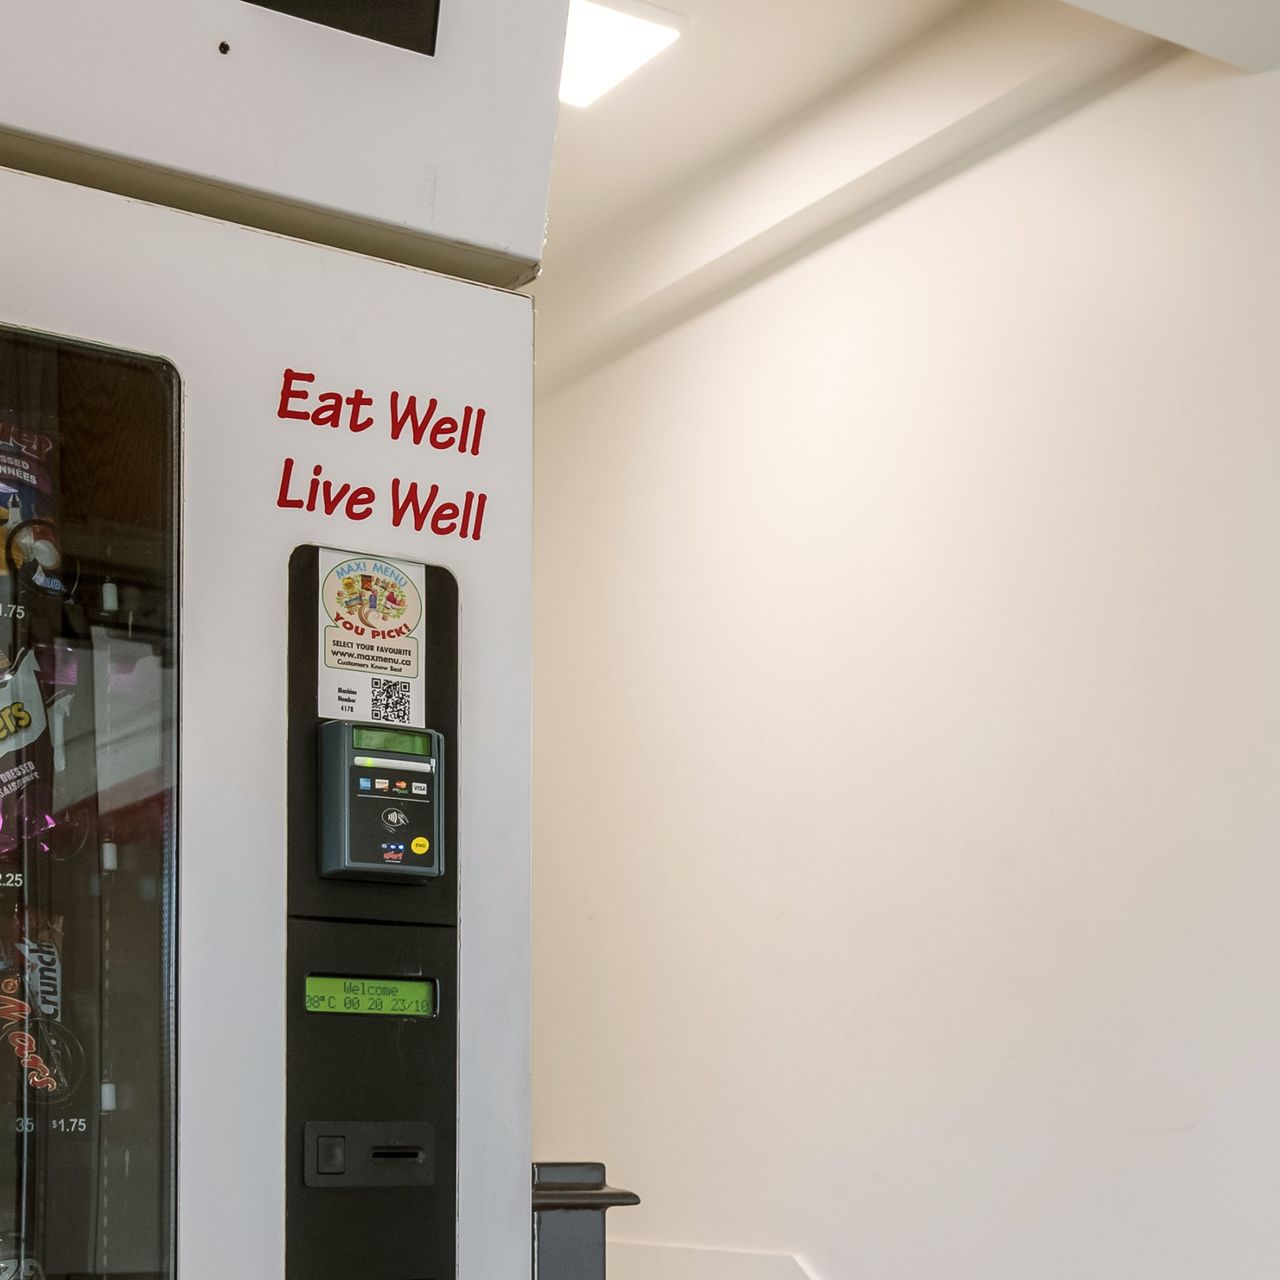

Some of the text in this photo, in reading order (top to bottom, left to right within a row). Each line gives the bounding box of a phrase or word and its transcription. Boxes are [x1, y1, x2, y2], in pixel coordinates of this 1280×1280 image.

[276, 367, 487, 456] Eat Well
[276, 457, 488, 541] Live Well
[372, 562, 409, 588] MENU
[333, 611, 412, 640] YOU PICK!
[330, 649, 412, 667] www.maxmenu.ca
[332, 639, 412, 657] SELECT YOUR FAVOURITE
[342, 981, 399, 997] Welcome
[15, 1117, 87, 1133] 35 $1.75
